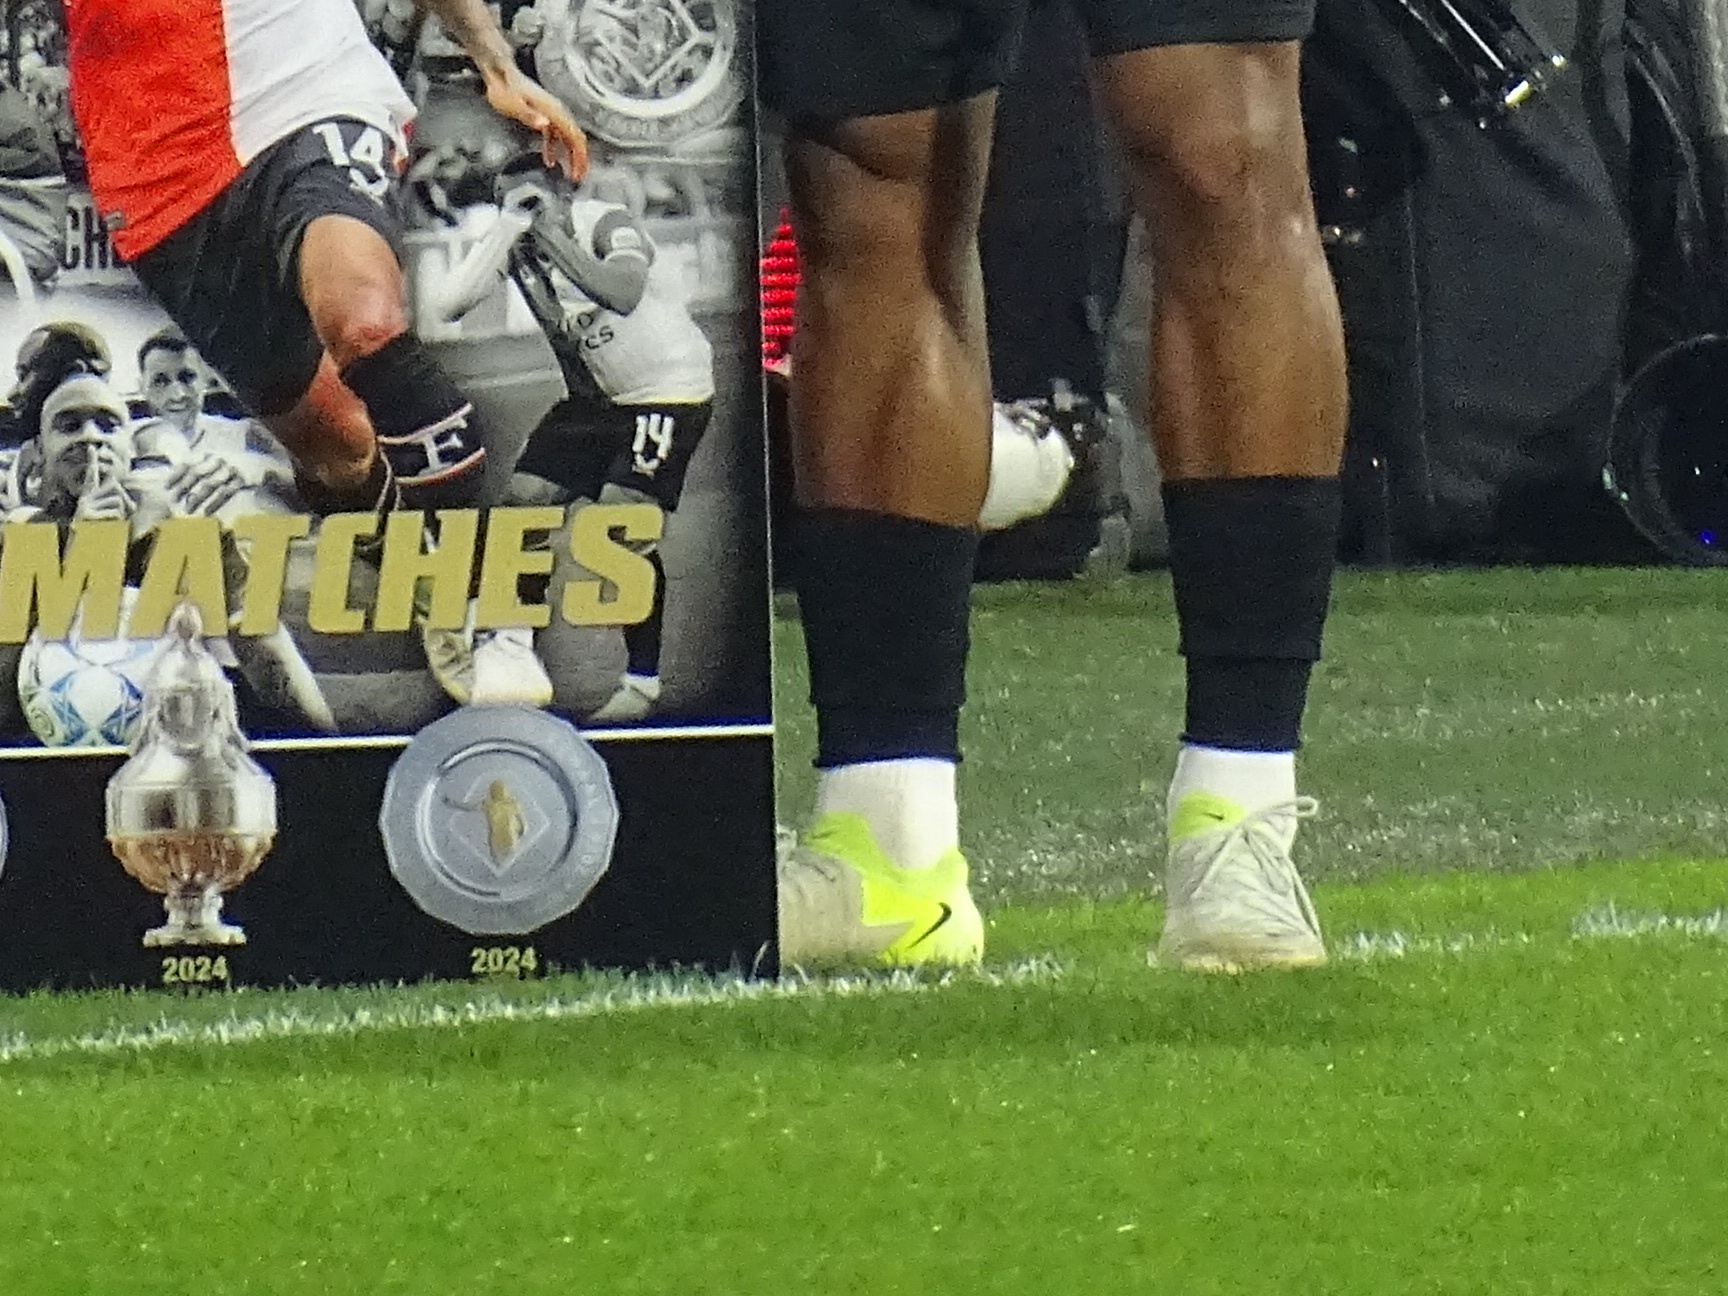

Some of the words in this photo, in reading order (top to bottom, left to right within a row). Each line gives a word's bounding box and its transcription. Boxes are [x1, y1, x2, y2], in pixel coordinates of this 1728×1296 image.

[312, 122, 386, 176] 14
[161, 955, 228, 984] 2024
[470, 946, 538, 975] 2024
